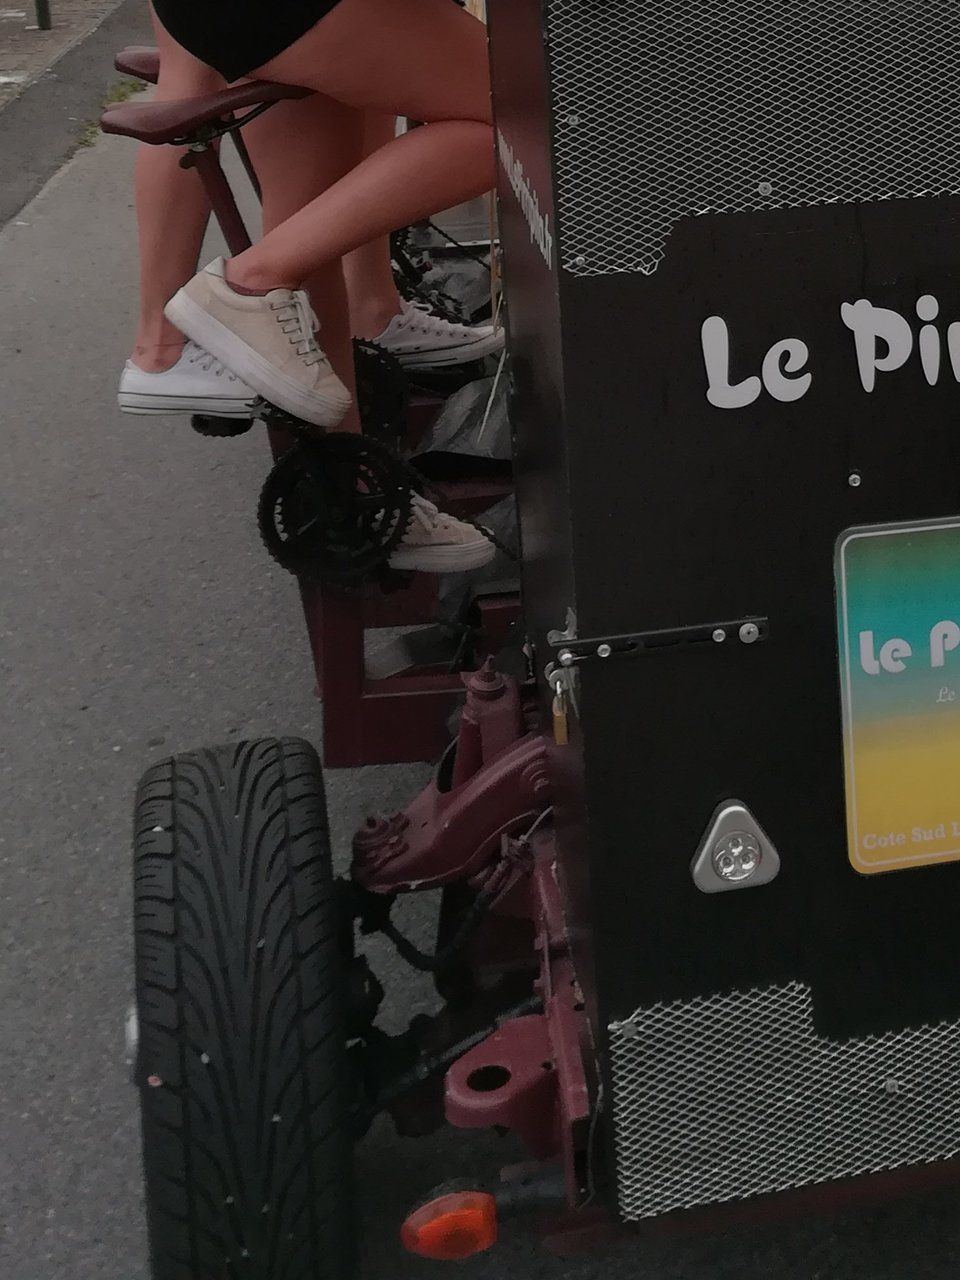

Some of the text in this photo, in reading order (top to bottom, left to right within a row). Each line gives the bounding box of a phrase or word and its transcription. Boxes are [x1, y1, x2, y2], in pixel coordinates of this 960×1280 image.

[701, 315, 812, 409] Le
[858, 630, 912, 676] Le
[936, 686, 956, 703] Le
[862, 831, 907, 850] Cote
[911, 824, 946, 843] Sud
